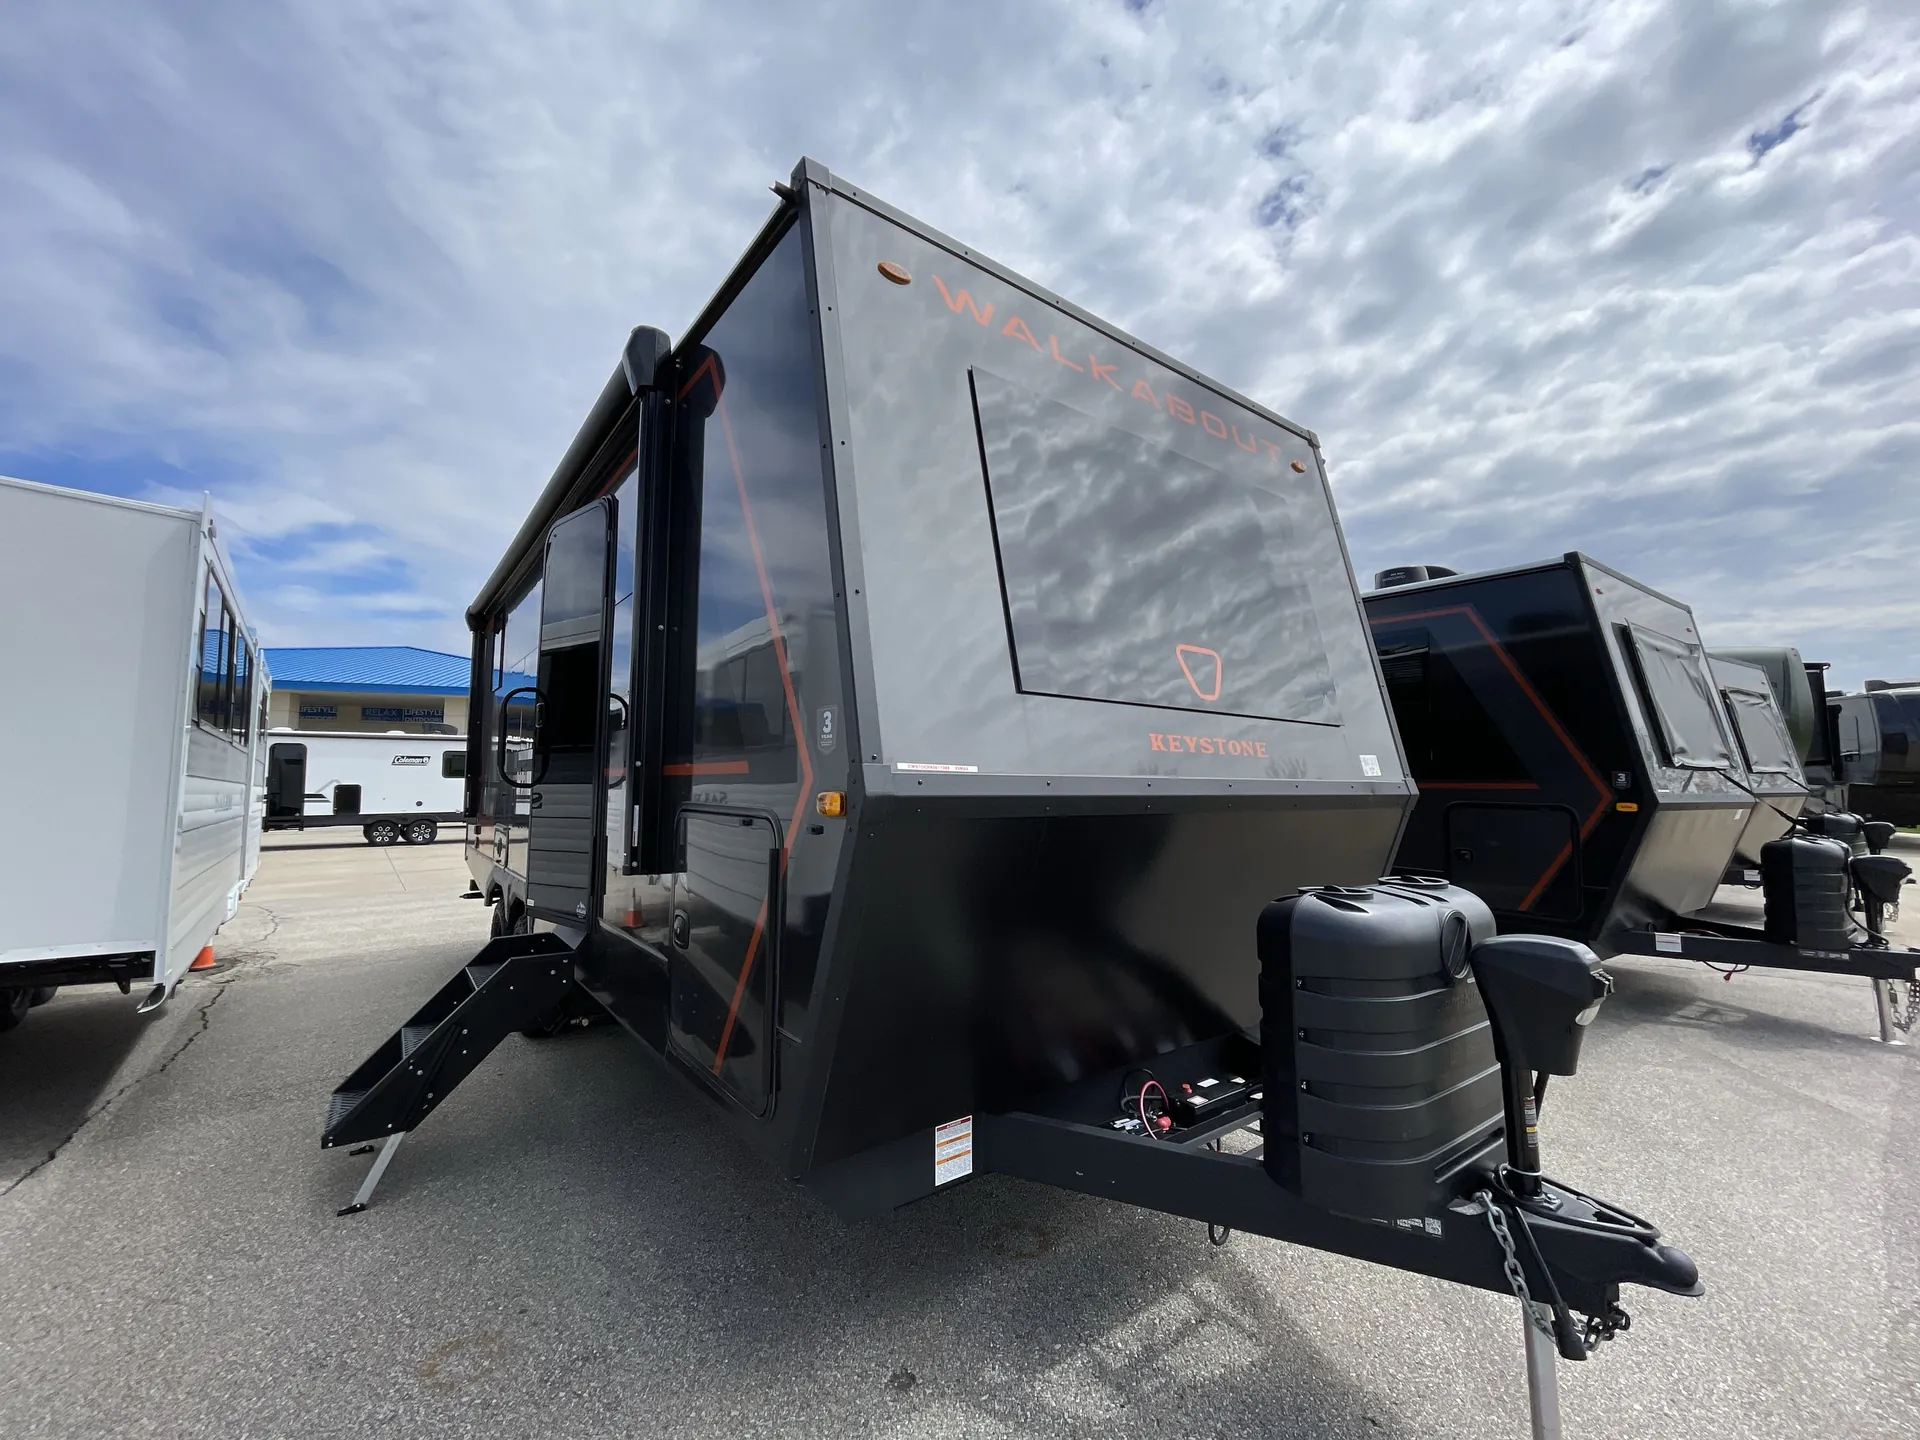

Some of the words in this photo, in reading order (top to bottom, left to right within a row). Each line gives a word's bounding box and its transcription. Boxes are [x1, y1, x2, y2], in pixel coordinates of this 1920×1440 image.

[931, 274, 1281, 465] WALKABOUT
[365, 708, 397, 717] RELAX
[404, 708, 443, 716] LIFESTYLE
[822, 710, 832, 733] 3
[1148, 732, 1269, 758] KEYSTONE
[394, 756, 422, 765] Coleman
[1617, 773, 1626, 782] 3
